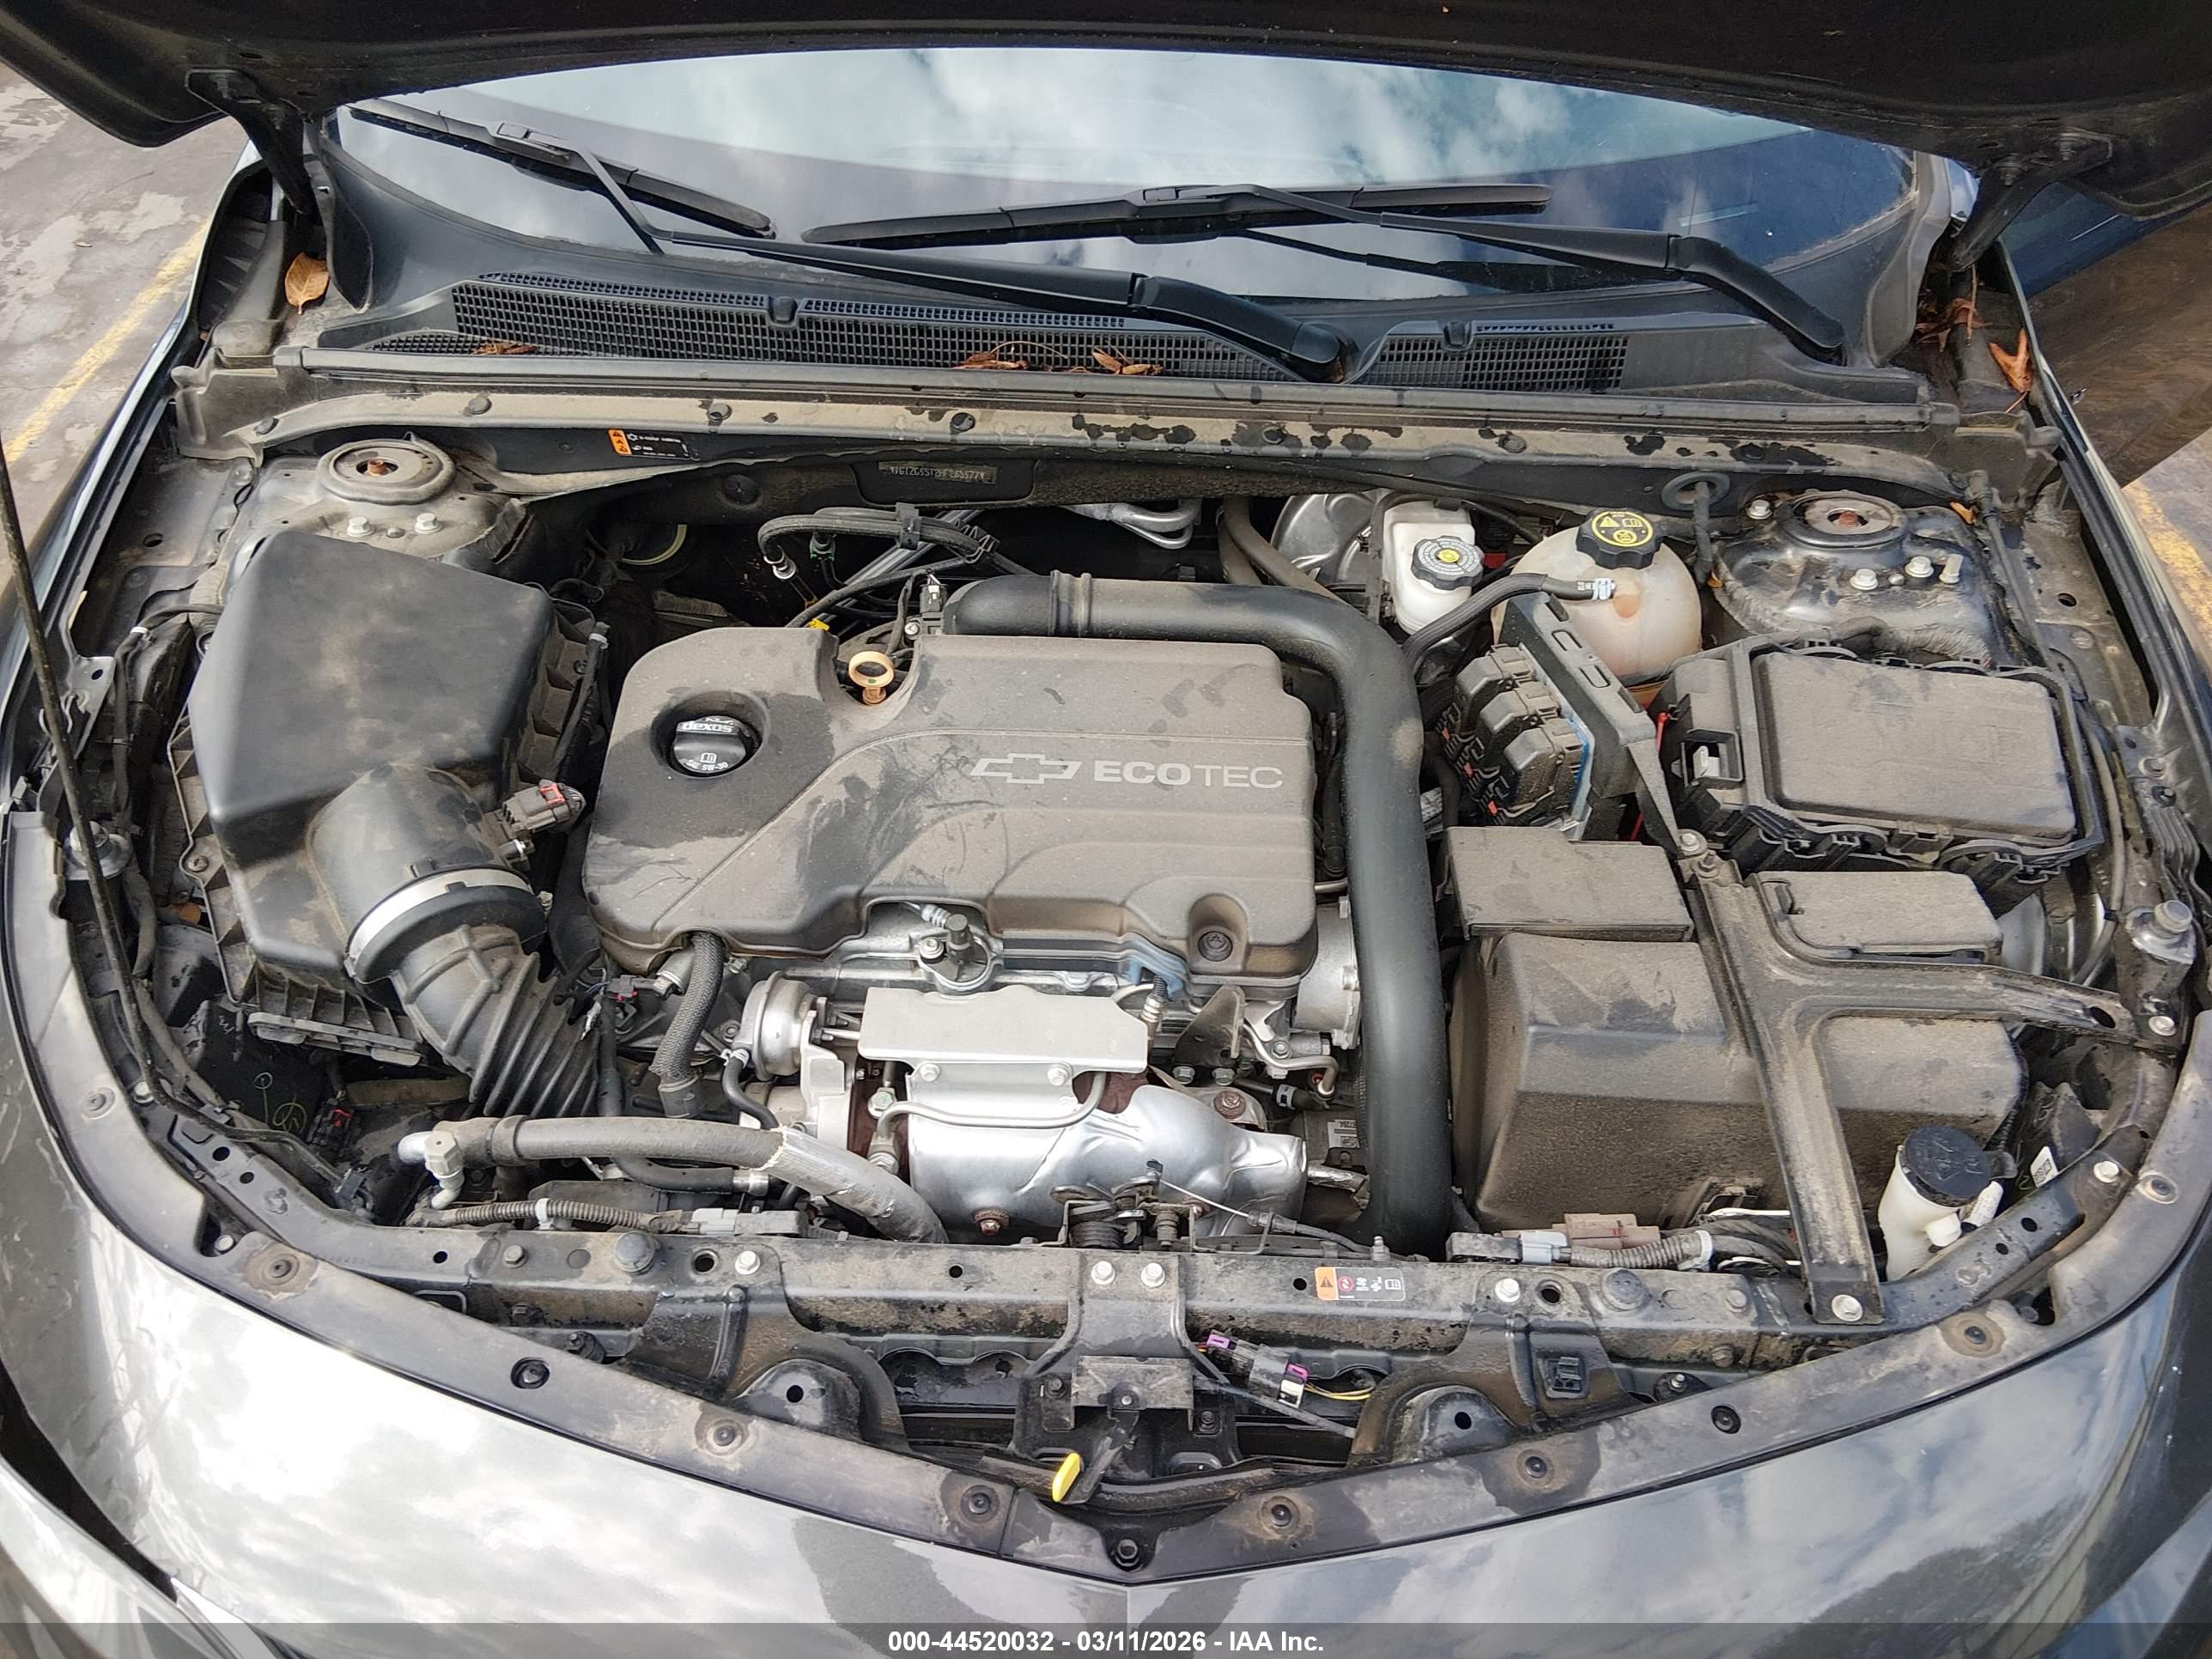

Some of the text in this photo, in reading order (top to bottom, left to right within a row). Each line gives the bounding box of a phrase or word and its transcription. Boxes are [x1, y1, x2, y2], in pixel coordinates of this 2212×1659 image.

[682, 720, 734, 733] dexos
[702, 762, 729, 771] 5W-30
[1093, 760, 1284, 789] ECOTEC
